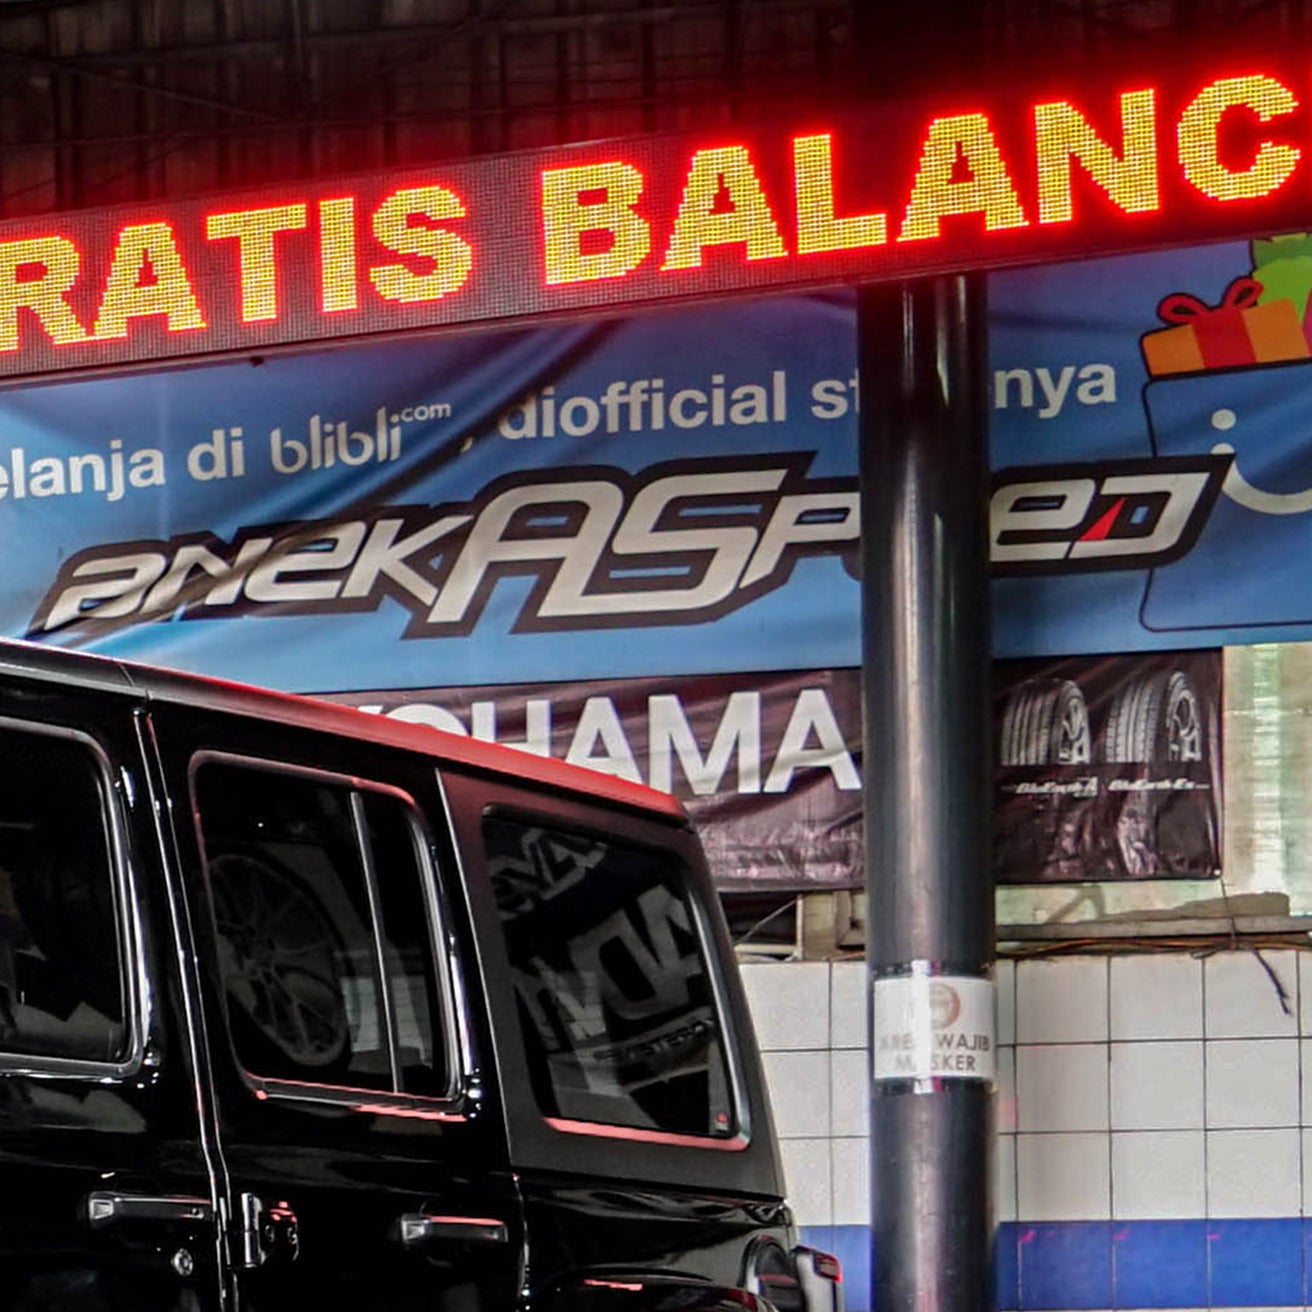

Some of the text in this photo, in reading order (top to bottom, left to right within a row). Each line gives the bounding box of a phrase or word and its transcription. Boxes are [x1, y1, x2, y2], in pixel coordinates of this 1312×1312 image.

[540, 73, 1302, 286] BALANC
[186, 427, 244, 483] di
[270, 407, 401, 474] blibli
[896, 1054, 977, 1072] MSKER
[936, 1031, 991, 1052] WAJIB
